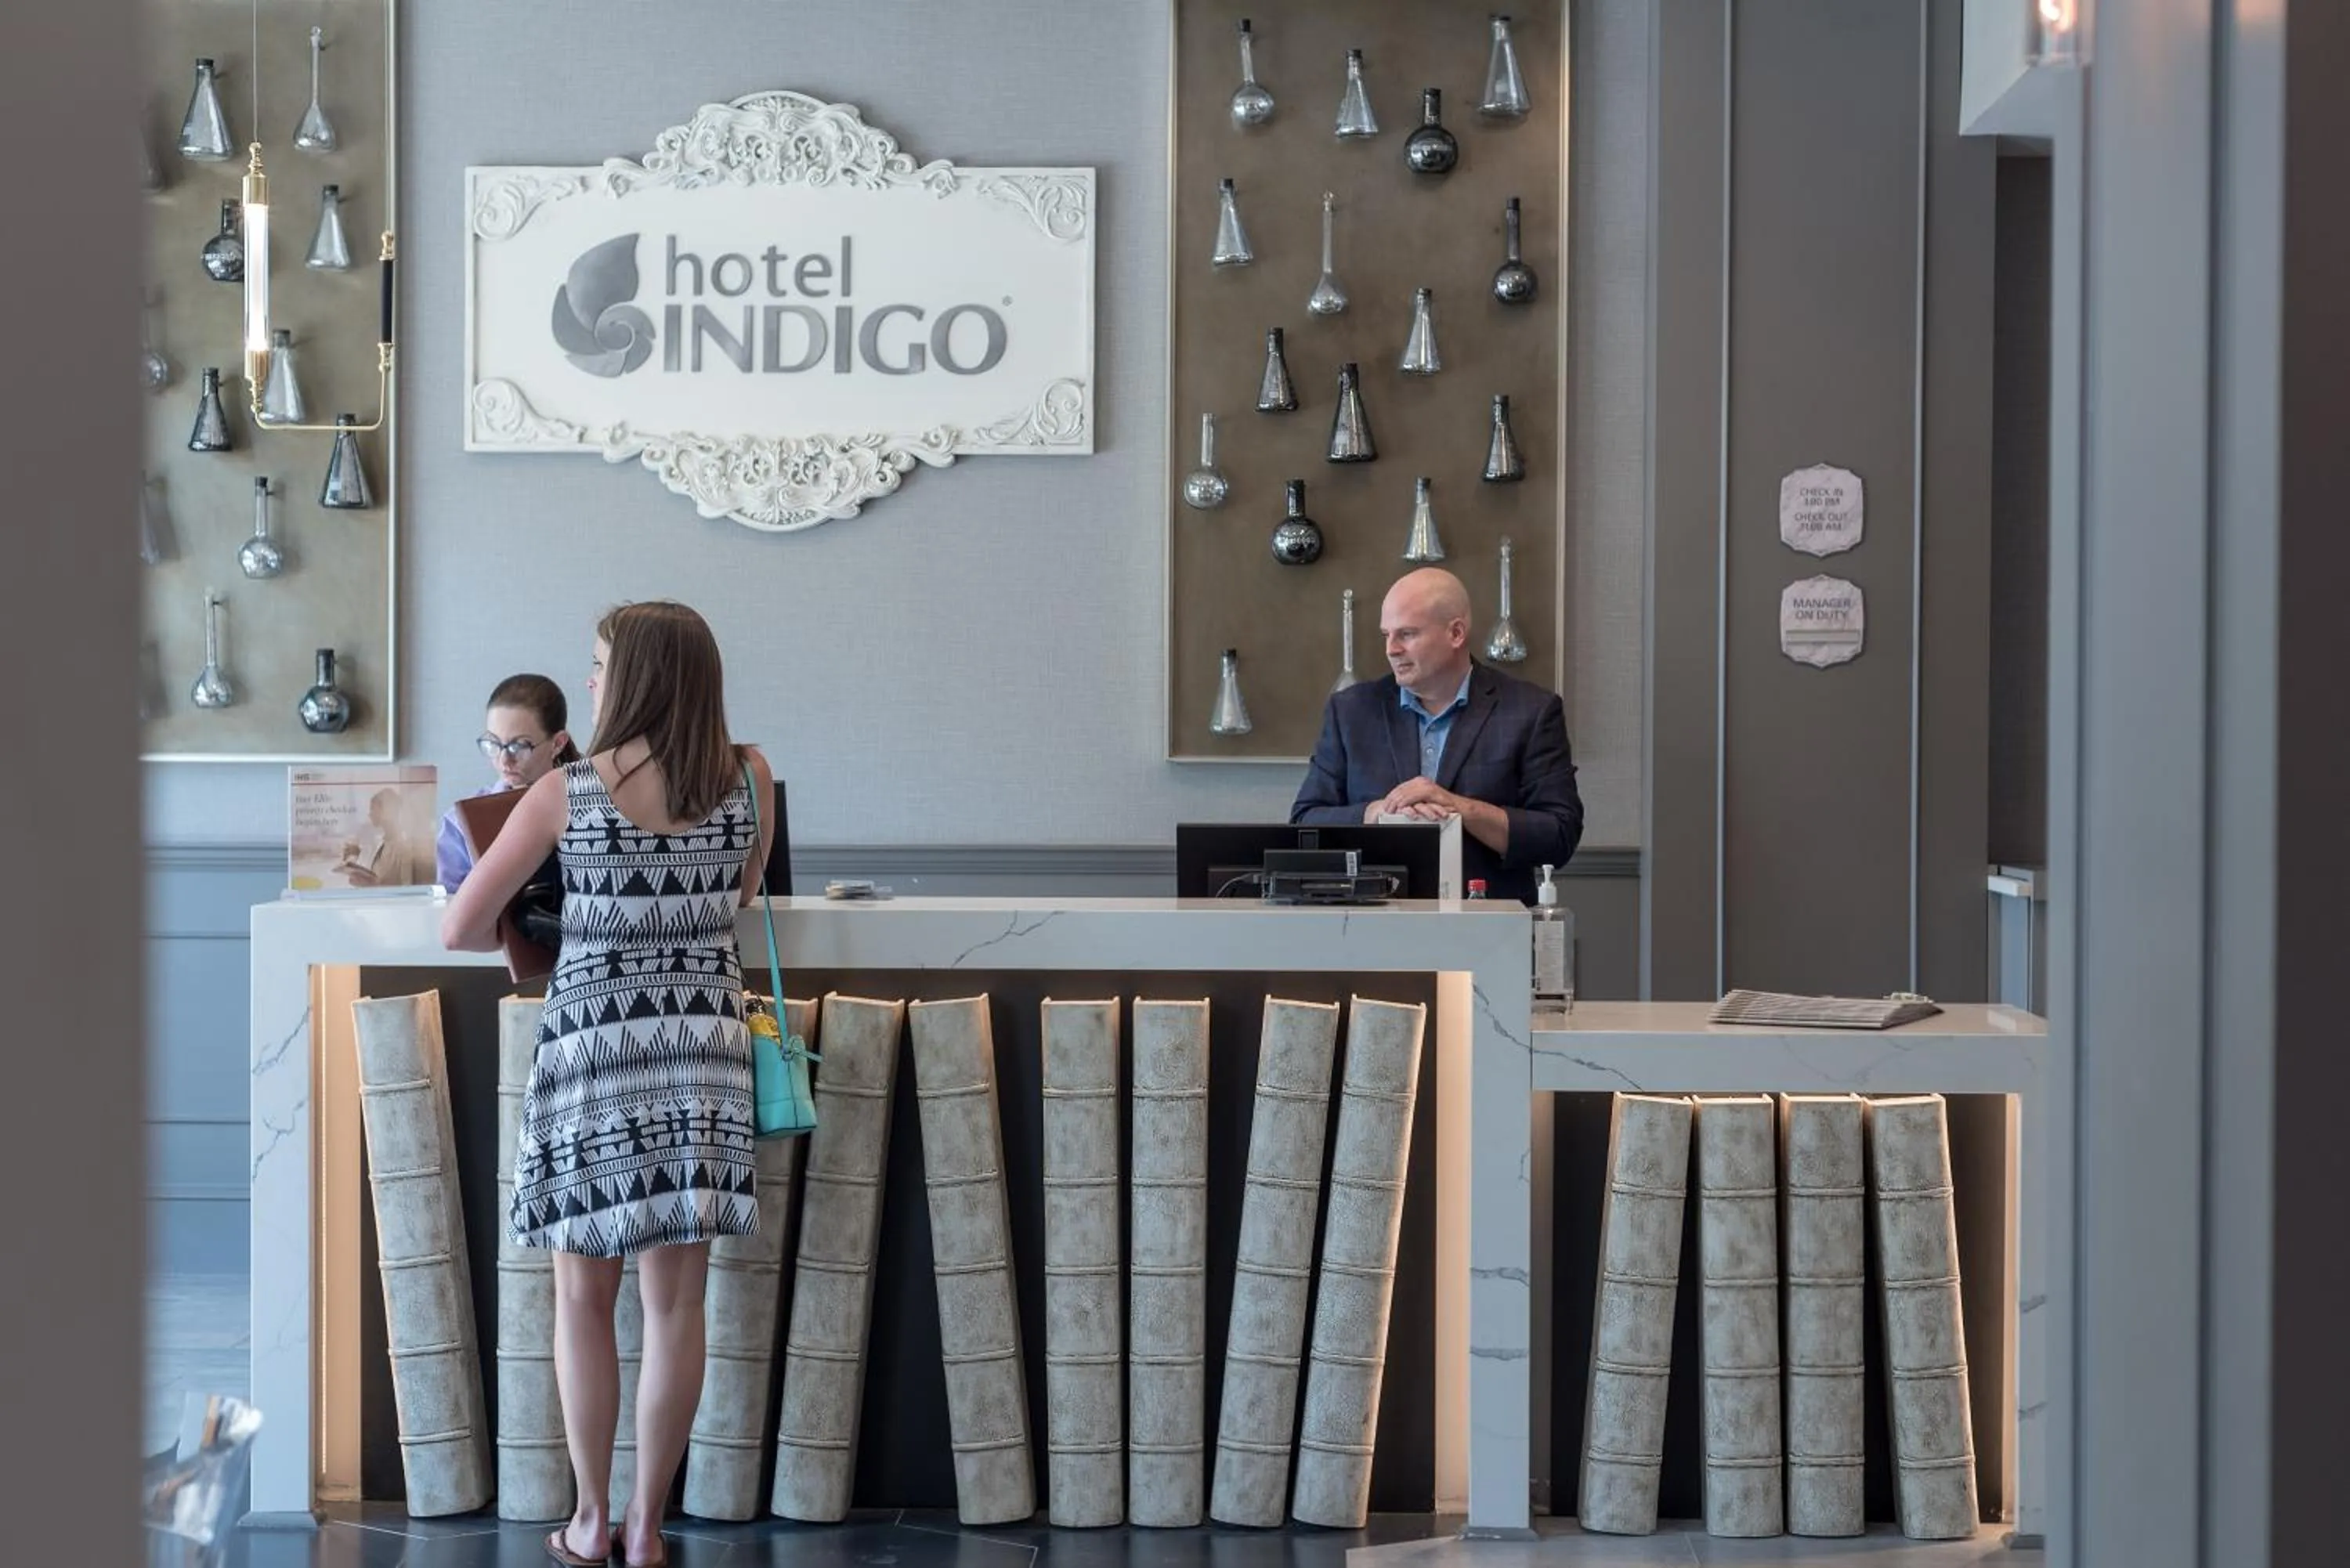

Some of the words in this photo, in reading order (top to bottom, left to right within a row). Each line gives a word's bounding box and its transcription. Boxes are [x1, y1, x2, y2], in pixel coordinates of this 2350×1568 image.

[666, 235, 851, 298] hotel
[663, 304, 1008, 376] INDIGO
[1800, 488, 1831, 497] CHECK
[1833, 488, 1844, 497] IN
[1825, 497, 1840, 506] PM
[1795, 512, 1826, 521] CHECK
[1828, 512, 1848, 521] OUT
[1825, 522, 1842, 532] AM
[1793, 598, 1852, 609] MANAGER
[1795, 610, 1814, 621] ON
[1817, 610, 1849, 621] DUTY
